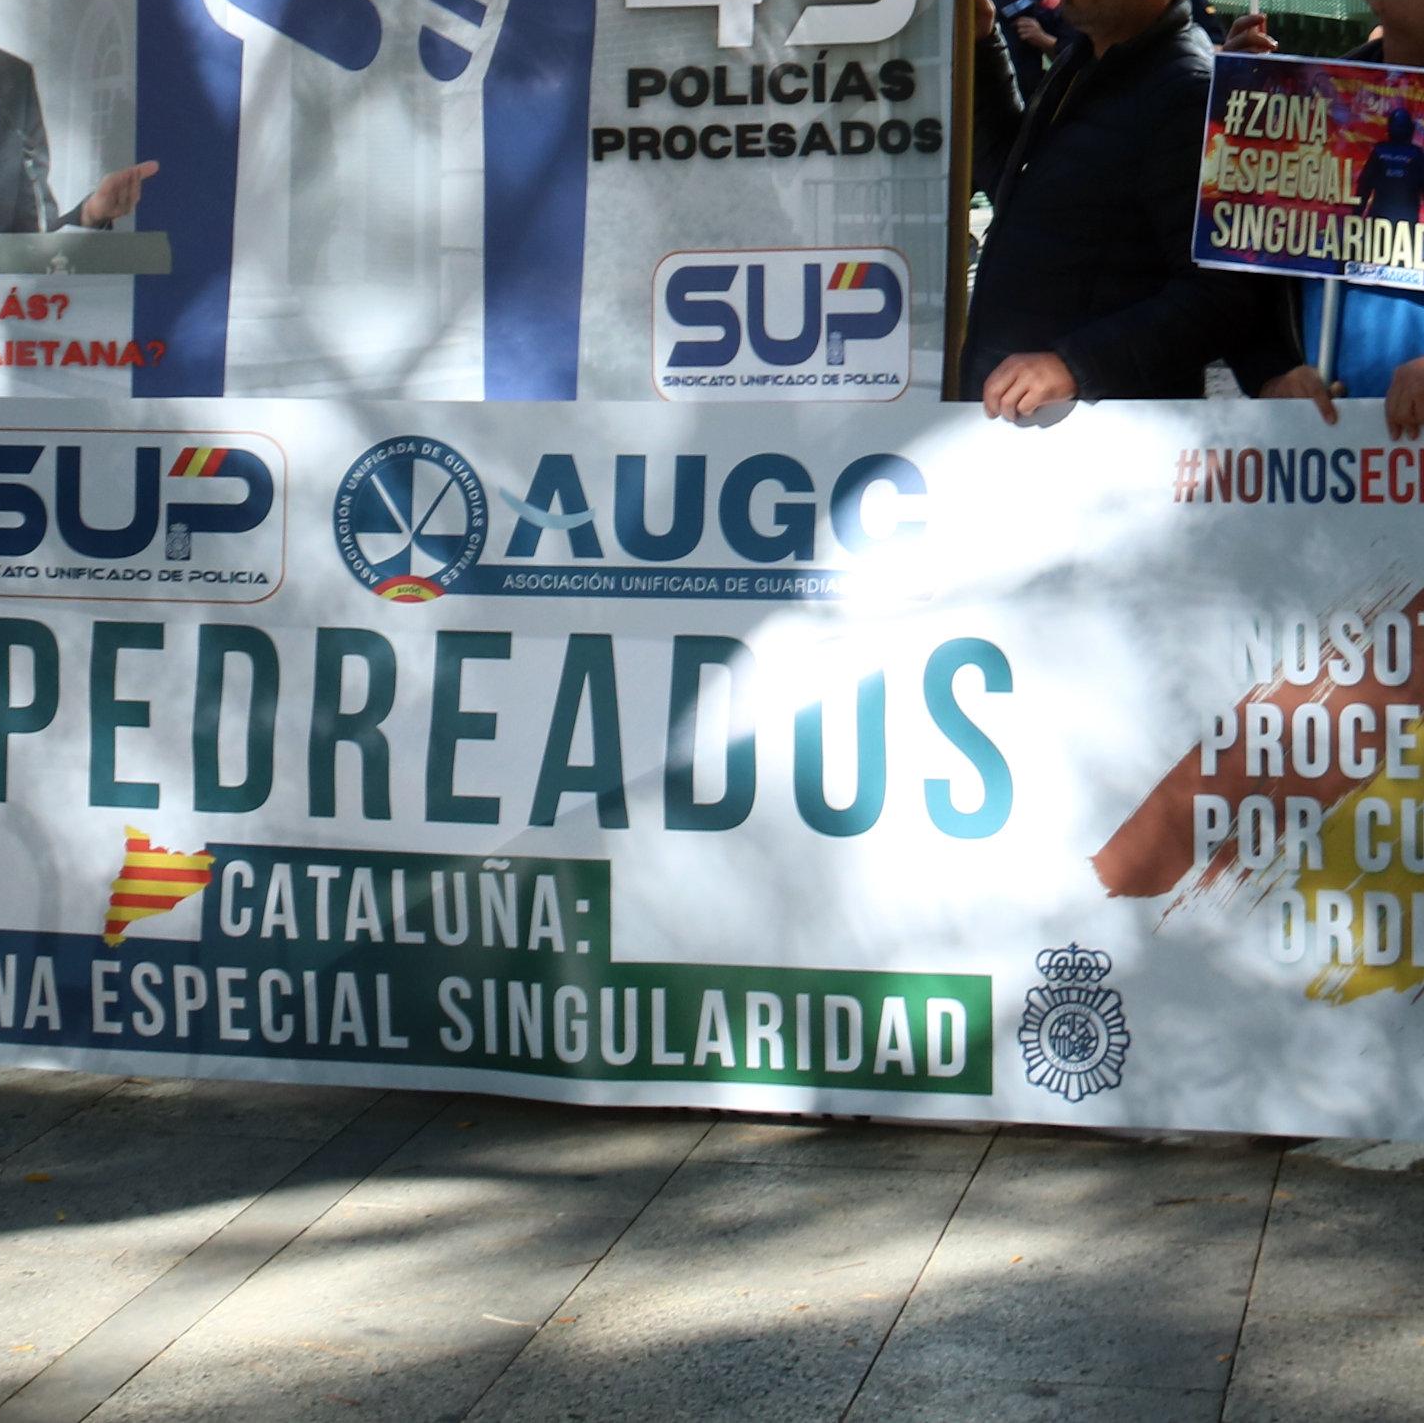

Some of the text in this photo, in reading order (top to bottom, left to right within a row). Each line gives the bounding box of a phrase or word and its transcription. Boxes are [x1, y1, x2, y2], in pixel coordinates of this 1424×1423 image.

[627, 51, 915, 109] POLICÍAS
[593, 118, 943, 163] PROCESADOS
[1224, 89, 1328, 145] #ZONA
[1217, 145, 1362, 206] ESPECIAL
[665, 261, 903, 368] SUP
[662, 374, 737, 388] SINDICATO
[741, 374, 817, 387] UNIFICADO
[821, 373, 840, 386] DE
[420, 442, 443, 458] DE
[506, 453, 928, 563] AUGC
[44, 565, 152, 582] UNIFICADO
[157, 568, 183, 583] DE
[188, 569, 270, 585] POLICIA
[502, 571, 841, 596] ASOCIACIÓN UNIFICADA DE GUARDIA
[1192, 793, 1323, 872] POR
[219, 857, 591, 956] CATALUÑA:
[91, 958, 408, 1050] ESPECIAL
[439, 975, 967, 1078] SINGULARIDAD
